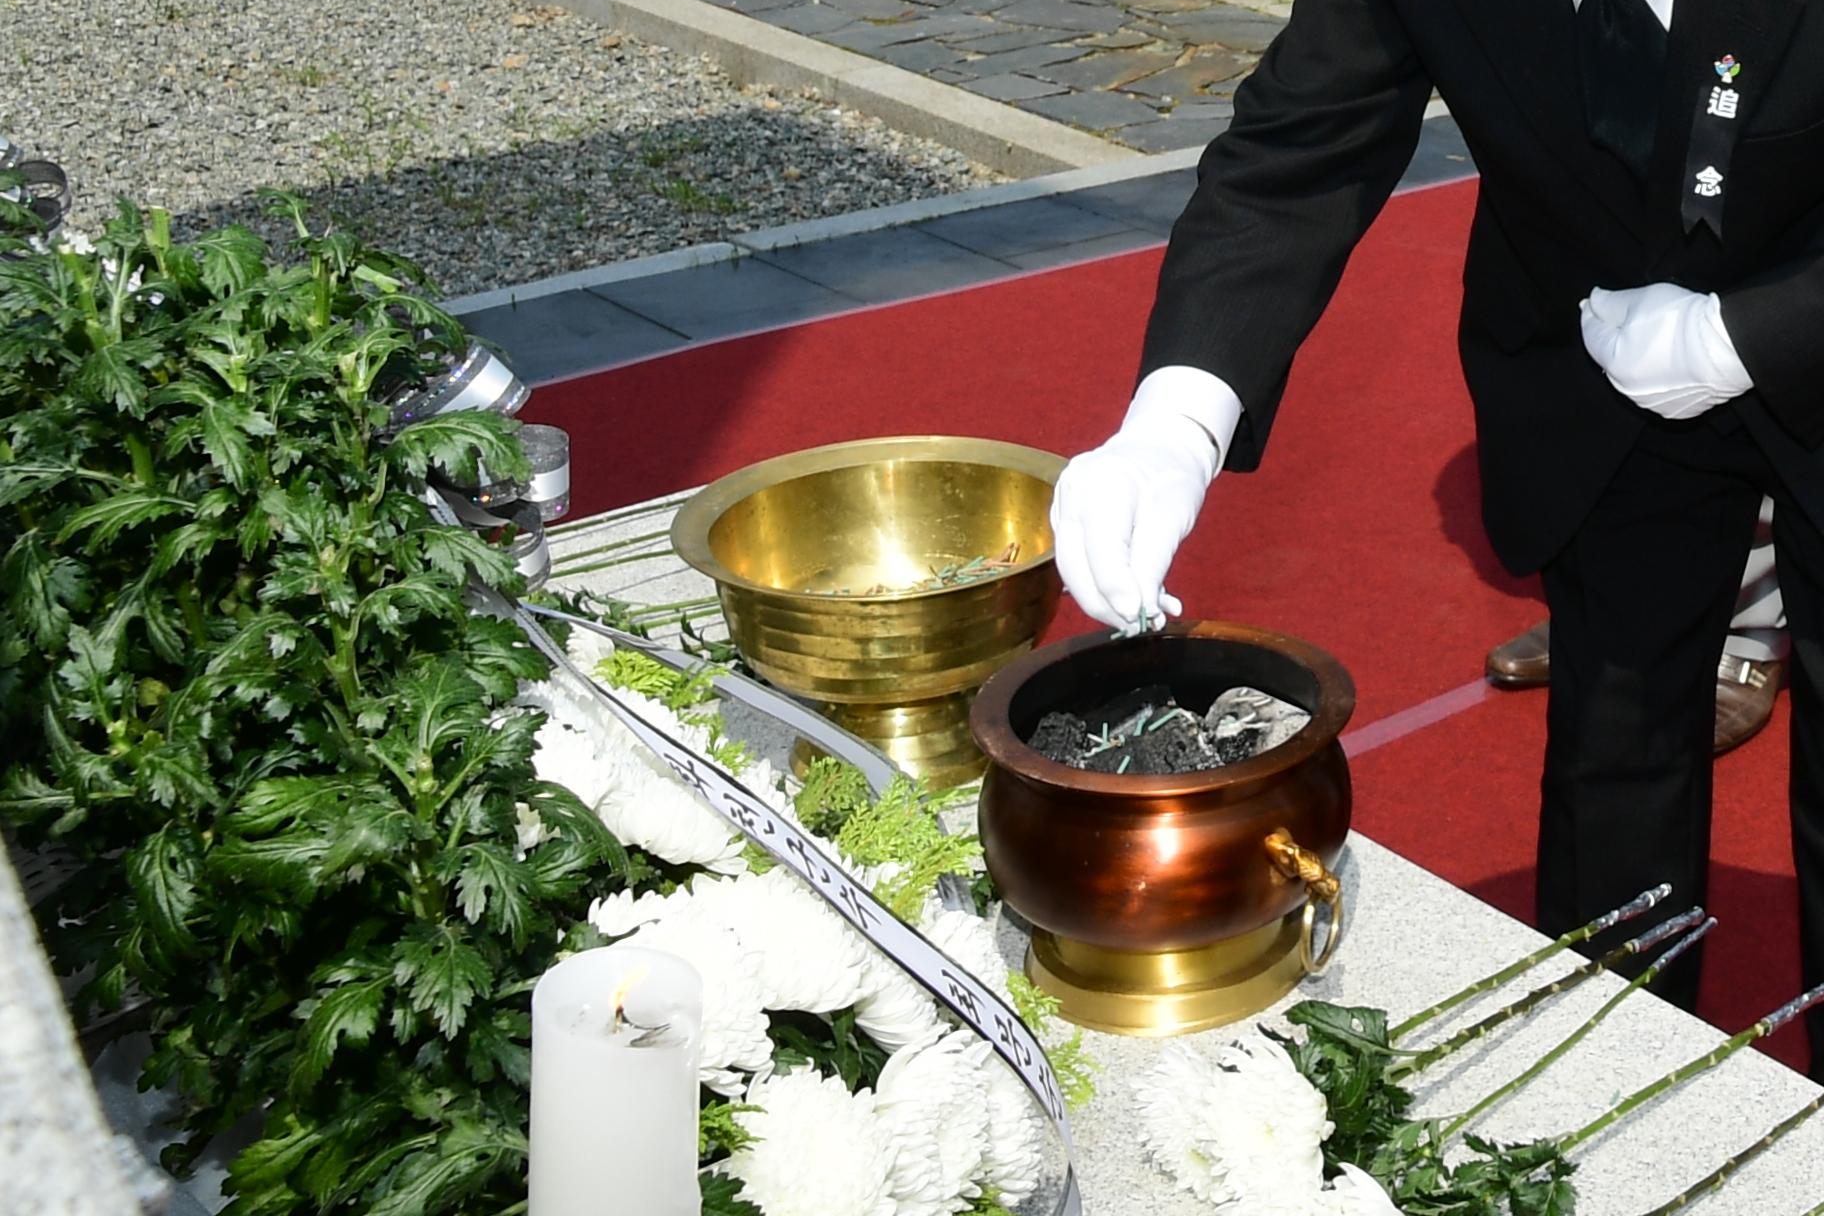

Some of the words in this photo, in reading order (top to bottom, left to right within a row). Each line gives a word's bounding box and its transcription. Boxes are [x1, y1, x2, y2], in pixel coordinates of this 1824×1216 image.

[1694, 86, 1740, 197] 追念
[663, 752, 882, 930] 화천군수
[940, 968, 1064, 1121] 최문순
